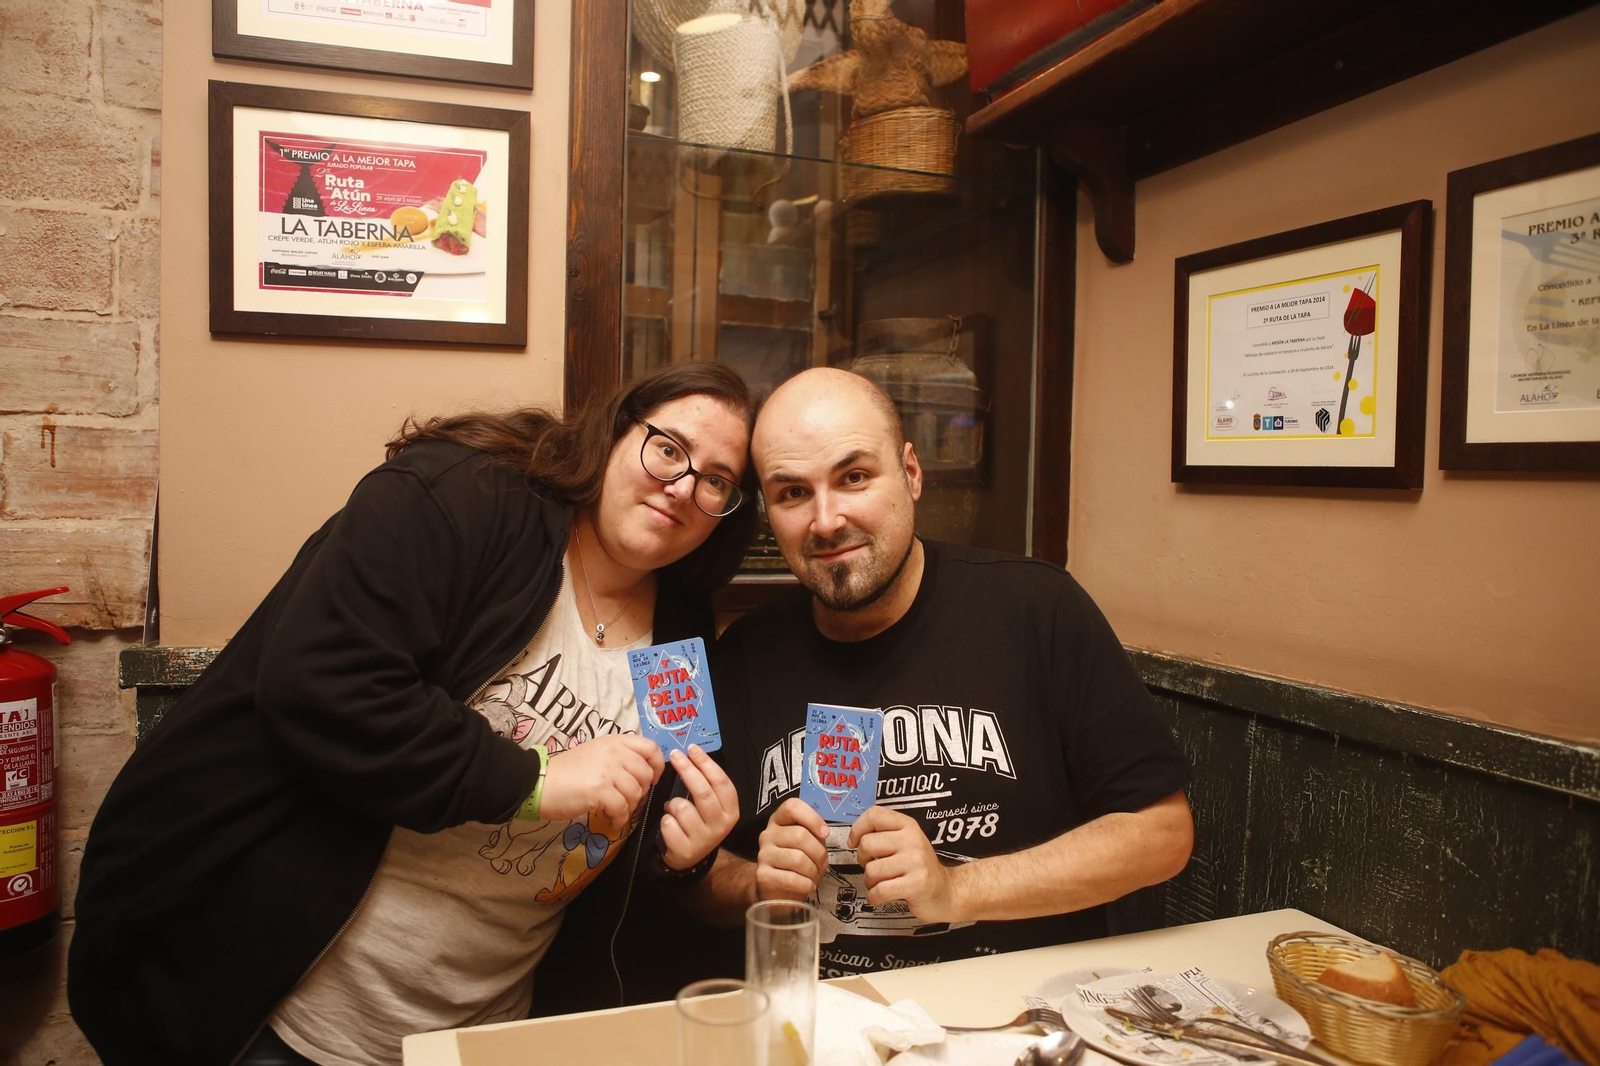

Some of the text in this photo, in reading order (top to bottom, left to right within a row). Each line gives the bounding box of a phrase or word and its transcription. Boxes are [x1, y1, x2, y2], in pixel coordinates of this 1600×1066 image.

[291, 150, 330, 161] PREMIO
[342, 154, 354, 163] LA
[357, 156, 390, 166] MEJOR
[393, 158, 416, 168] TAPA
[325, 174, 364, 189] Ruta
[330, 188, 371, 202] Atún
[281, 217, 414, 242] LA TABERNA
[1528, 212, 1600, 236] PREMIO A
[291, 236, 316, 244] VERDE,
[339, 239, 359, 247] ROJO
[361, 240, 366, 248] Y
[393, 243, 427, 251] AMARILLA
[1537, 278, 1592, 292] Concedido a
[1251, 304, 1269, 313] PREMIO
[1281, 300, 1298, 308] MEJOR
[1269, 315, 1282, 323] RUTA
[1297, 311, 1311, 319] TAPA
[1526, 324, 1537, 332] En
[1539, 323, 1550, 331] La
[1577, 318, 1589, 326] de
[1591, 317, 1600, 325] la
[647, 667, 692, 690] RUTA
[649, 685, 698, 709] DE LA
[656, 703, 698, 726] TAPA
[8, 744, 35, 754] SEGURIDAD
[819, 733, 861, 753] RUTA
[815, 751, 862, 772] DE LA
[19, 769, 27, 777] C
[817, 768, 858, 789] TAPA
[926, 802, 1000, 820] licensed since
[931, 812, 1000, 845] 1978
[819, 950, 874, 968] erican
